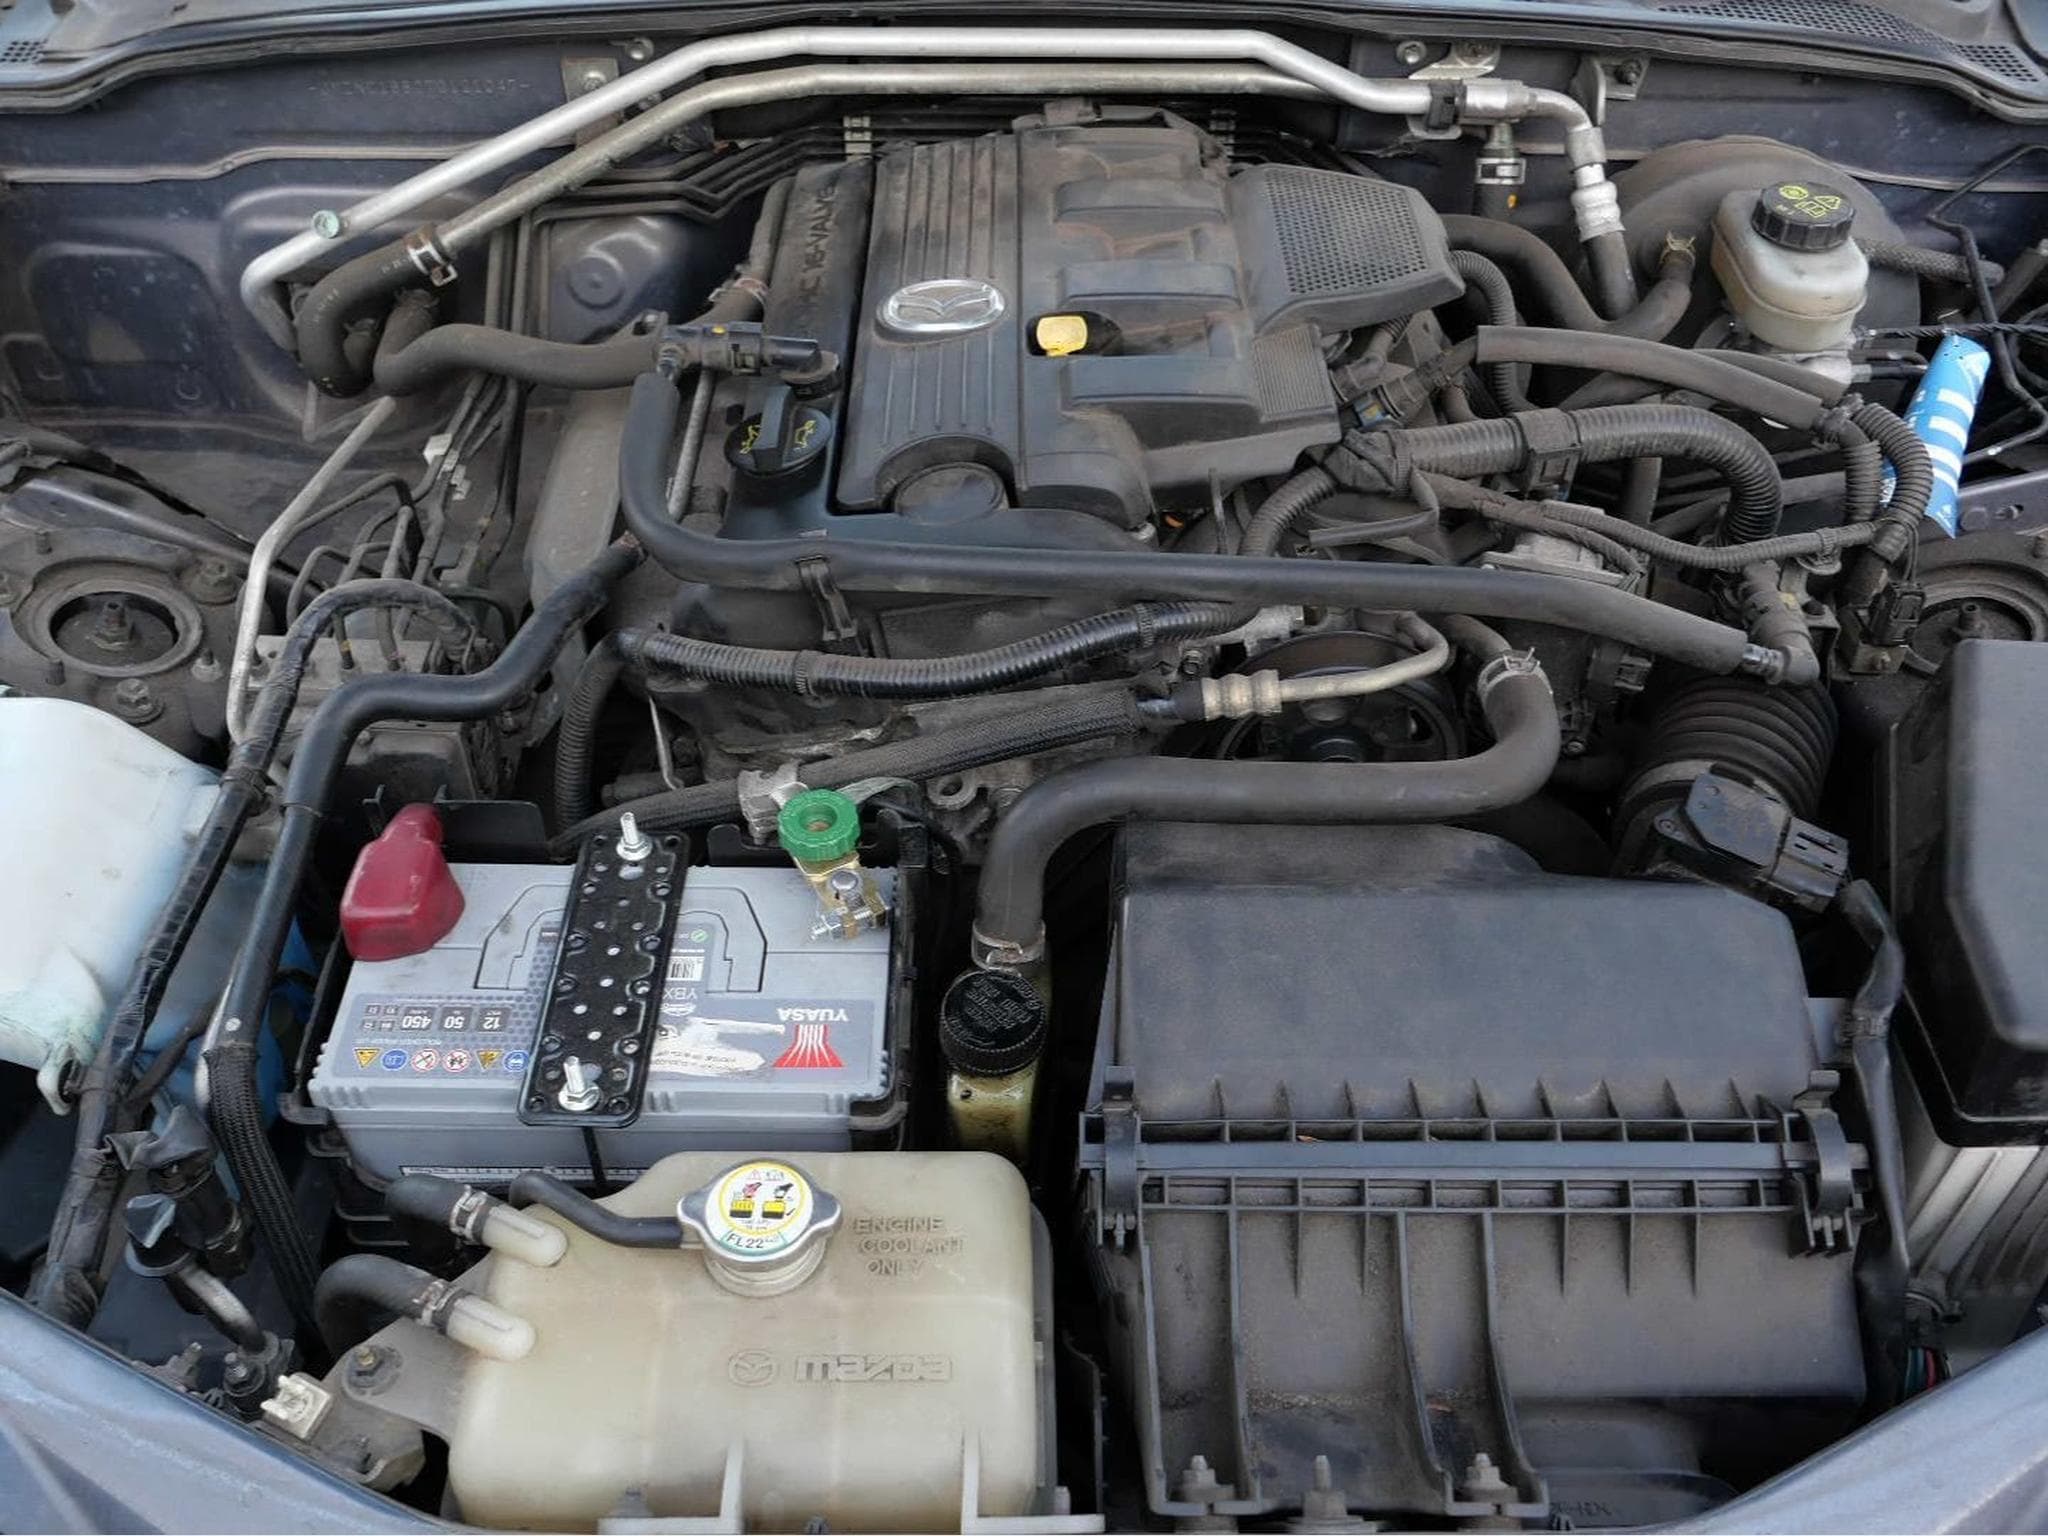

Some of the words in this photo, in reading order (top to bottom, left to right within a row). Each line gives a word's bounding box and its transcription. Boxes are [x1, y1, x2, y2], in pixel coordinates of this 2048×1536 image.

[401, 1015, 432, 1030] 450
[777, 1008, 849, 1022] YUASA
[444, 1016, 466, 1030] 50
[483, 1017, 501, 1030] 12
[853, 1217, 945, 1235] ENGINE
[725, 1231, 766, 1250] FL22
[858, 1237, 964, 1253] COOLANT
[867, 1259, 924, 1276] ONLY
